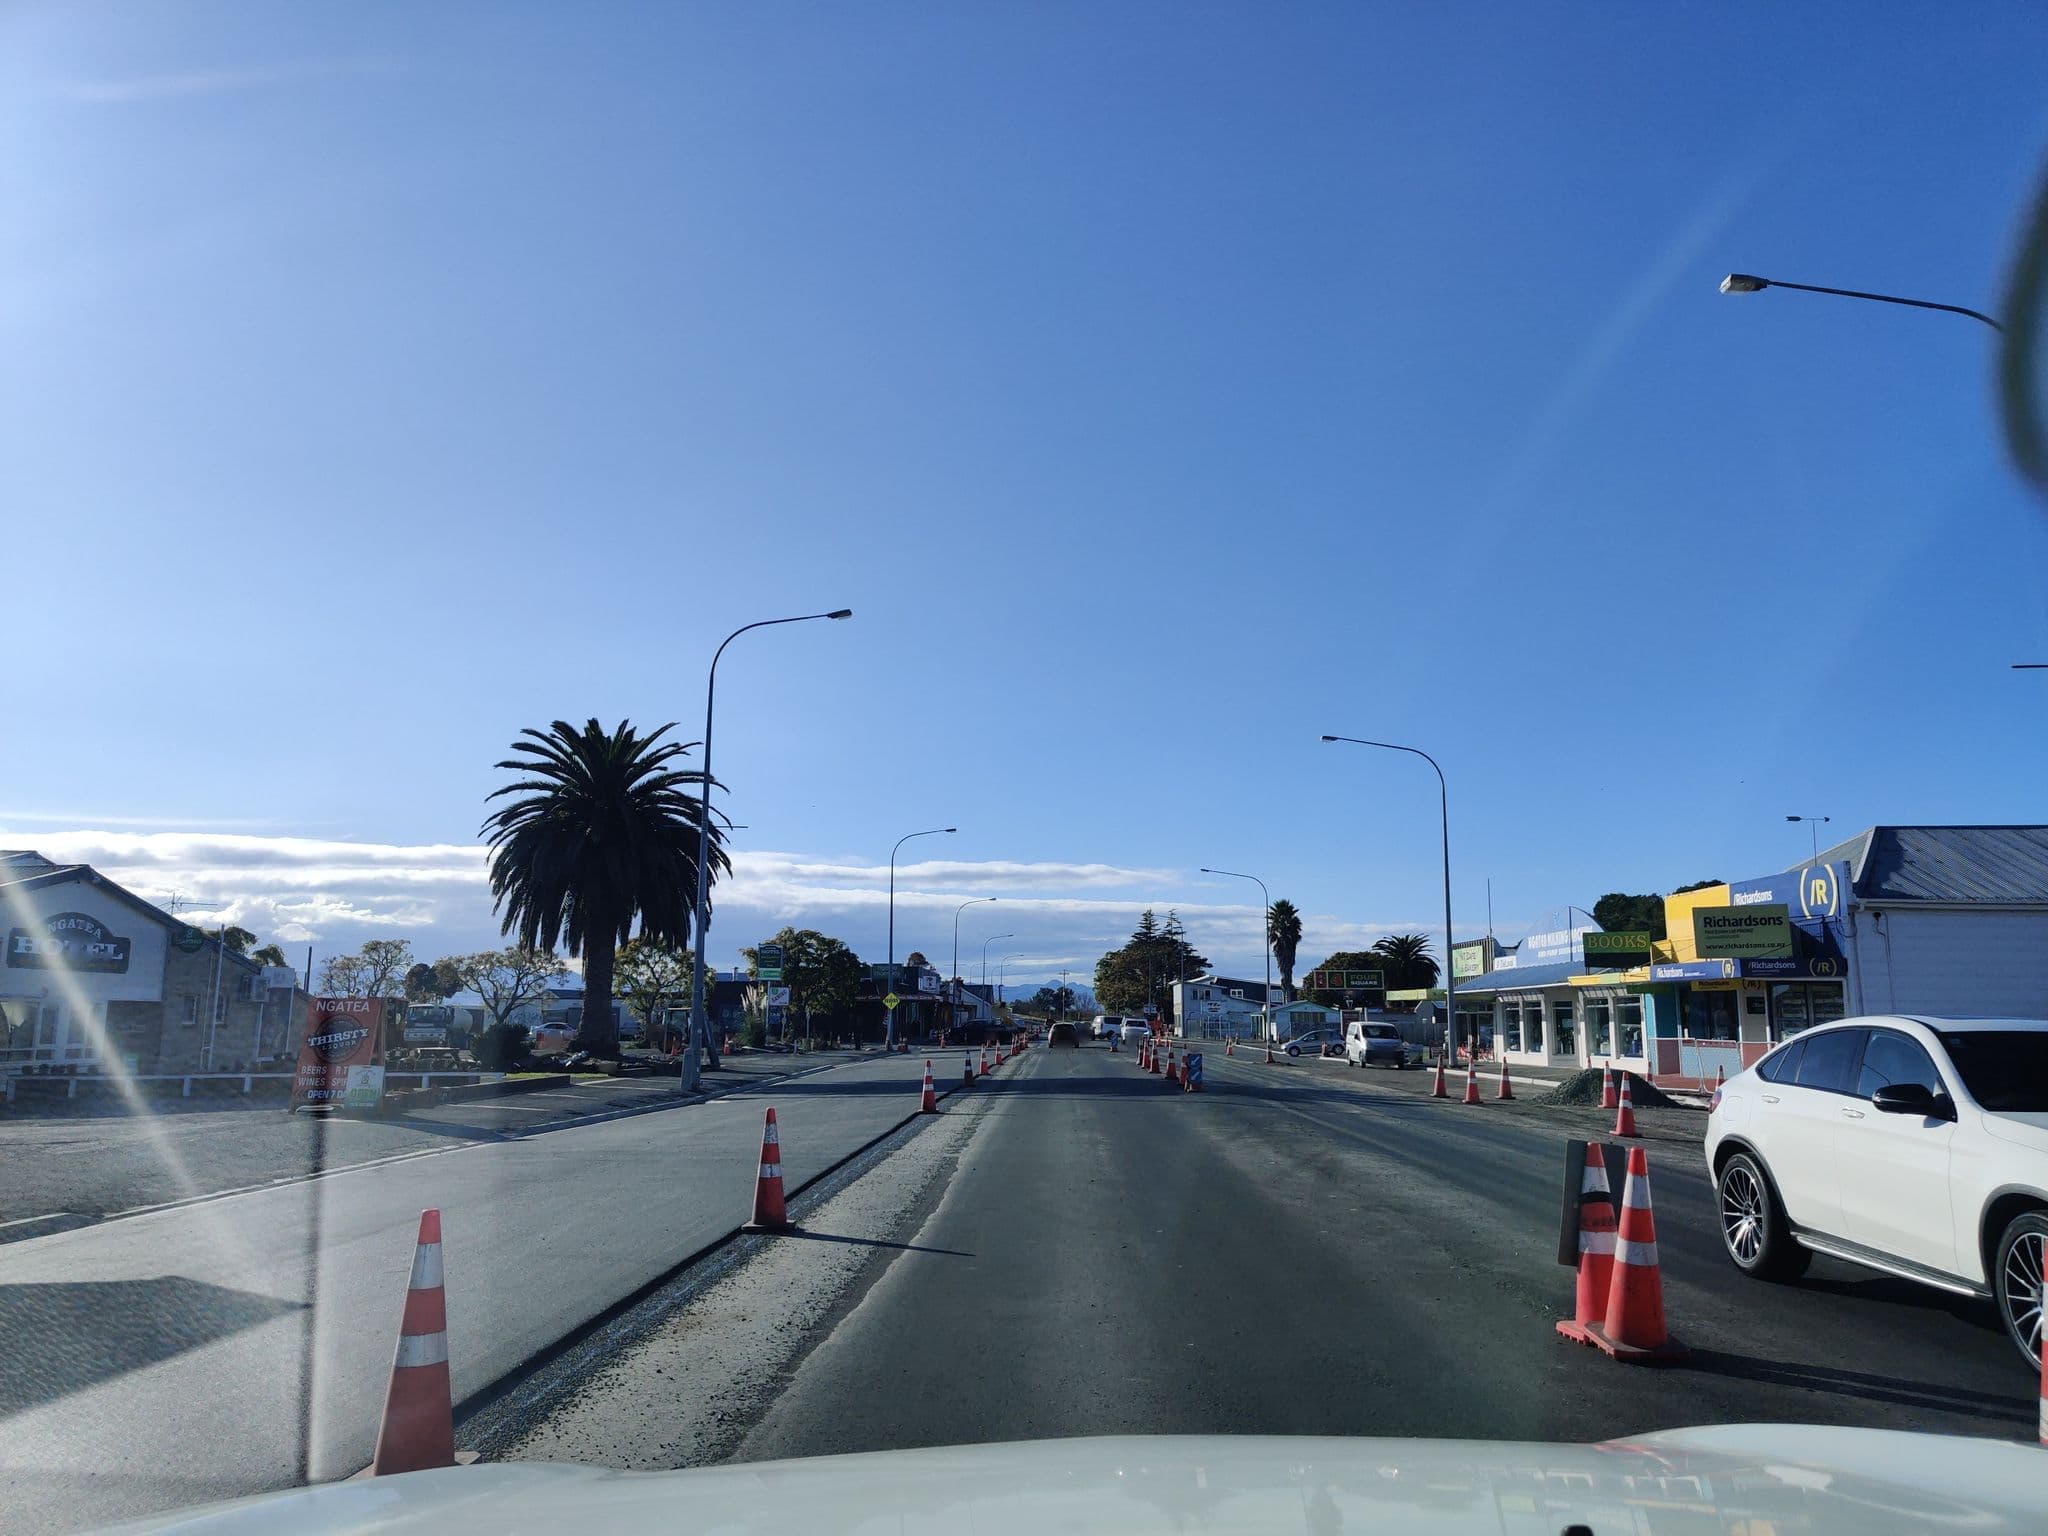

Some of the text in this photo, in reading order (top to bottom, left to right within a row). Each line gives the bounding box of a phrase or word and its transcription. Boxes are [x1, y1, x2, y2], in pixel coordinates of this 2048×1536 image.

[1703, 915, 1783, 928] Richardsons
[46, 919, 104, 939] NGATEA
[1588, 935, 1647, 948] BOOKS
[316, 1001, 370, 1012] NGATEA
[308, 1028, 369, 1046] THIRSTY
[302, 1065, 327, 1074] BEERS
[298, 1077, 326, 1087] WINES
[307, 1090, 328, 1098] OPEN
